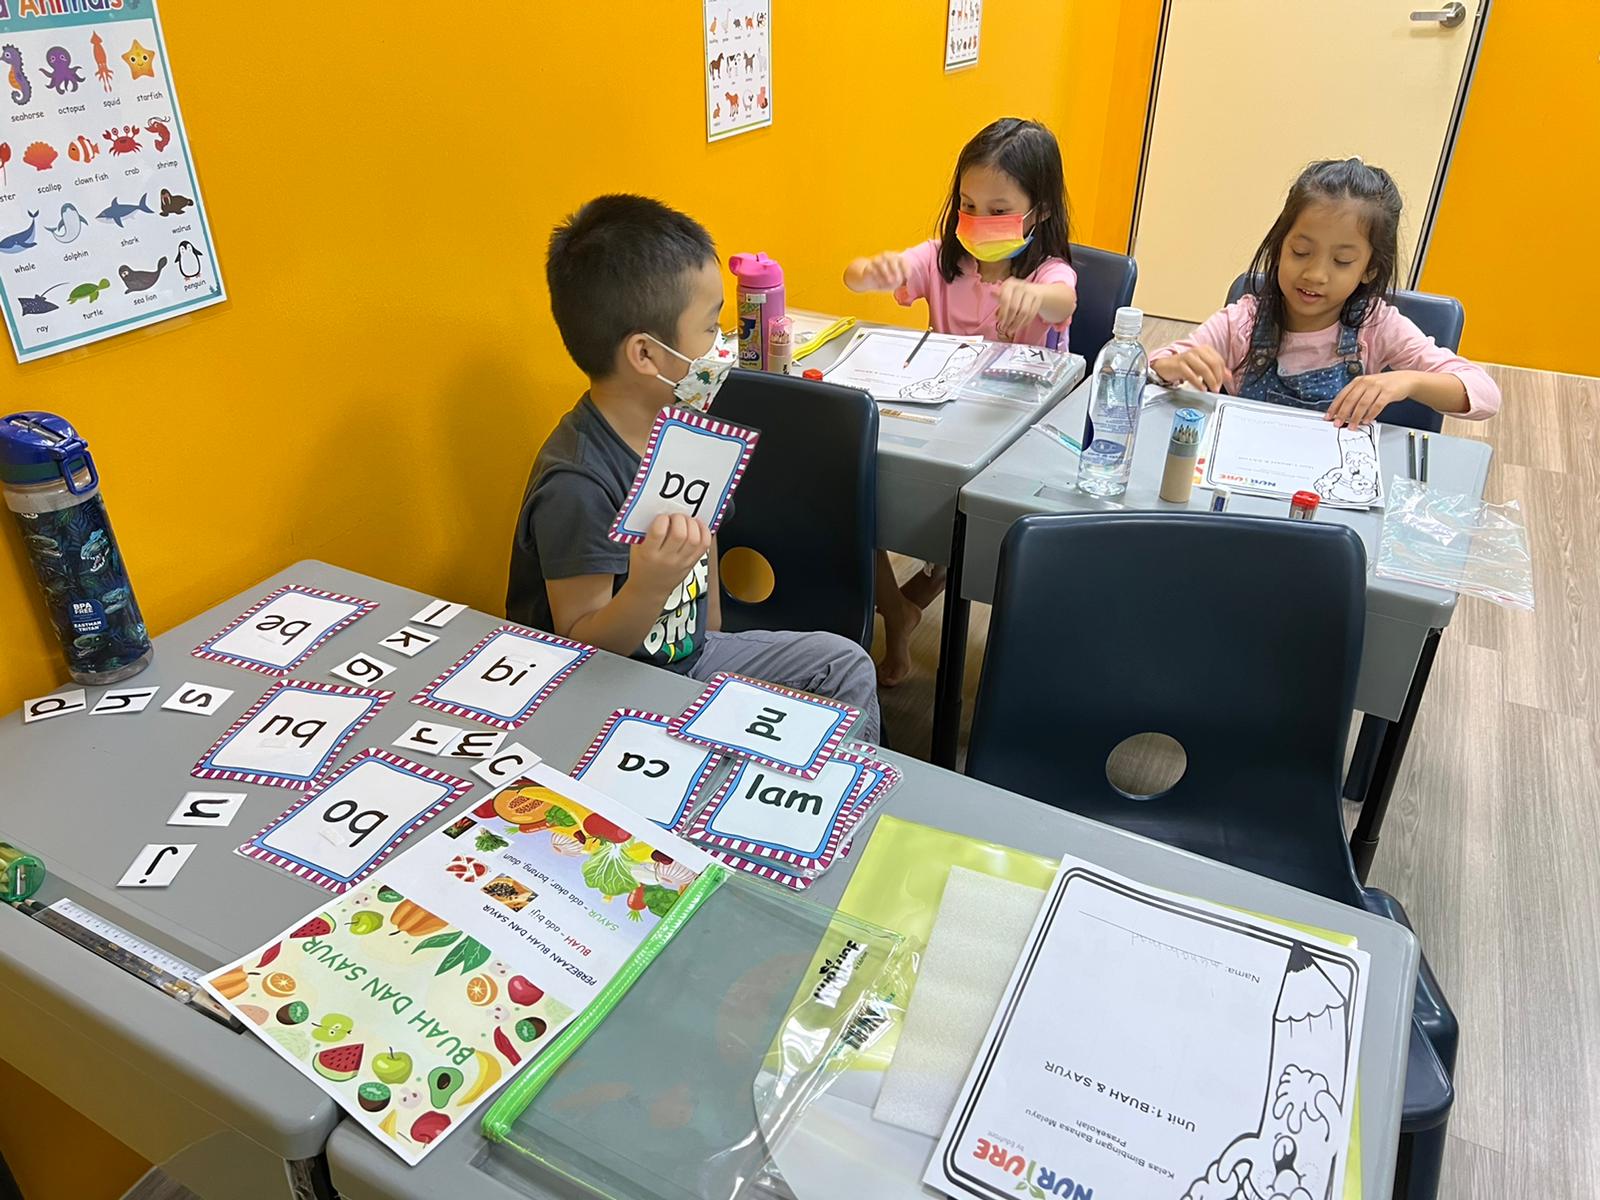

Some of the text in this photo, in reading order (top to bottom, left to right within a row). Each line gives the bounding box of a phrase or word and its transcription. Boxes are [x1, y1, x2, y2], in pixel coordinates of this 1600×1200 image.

[103, 98, 121, 108] squid
[136, 92, 163, 102] starfish
[58, 104, 86, 115] octopus
[11, 111, 45, 122] seahorse
[124, 166, 140, 176] crab
[156, 160, 178, 170] shrimp
[74, 173, 109, 186] clown fish
[37, 183, 62, 194] scallop
[172, 224, 192, 235] walrus
[120, 237, 139, 247] shark
[63, 250, 89, 262] dolphin
[14, 263, 36, 274] whale
[184, 279, 207, 292] penguin
[133, 293, 158, 306] sea lion
[83, 309, 104, 320] turtle
[36, 325, 49, 334] ray
[73, 602, 93, 610] BPA
[74, 620, 102, 629] EASTMAN
[255, 614, 312, 646] be
[480, 655, 537, 686] bi
[180, 688, 212, 708] s
[744, 774, 824, 816] lam
[322, 799, 389, 848] bo
[503, 853, 521, 866] daun
[568, 894, 584, 907] ada
[528, 908, 546, 922] biji
[588, 908, 620, 932] SAYUR
[544, 918, 561, 933] ada
[482, 904, 598, 987] PERBEZAAN BUAH DAN SAYUR
[563, 935, 592, 957] BUAH
[301, 936, 476, 1066] BUAH DAN SAYUR
[1044, 1060, 1093, 1088] SAYUR
[1096, 1082, 1107, 1093] &
[1167, 1112, 1196, 1133] Unit
[1075, 1119, 1127, 1148] Prasekolah
[1025, 1108, 1175, 1180] Kelas Bimbingan Bahasa Melayu
